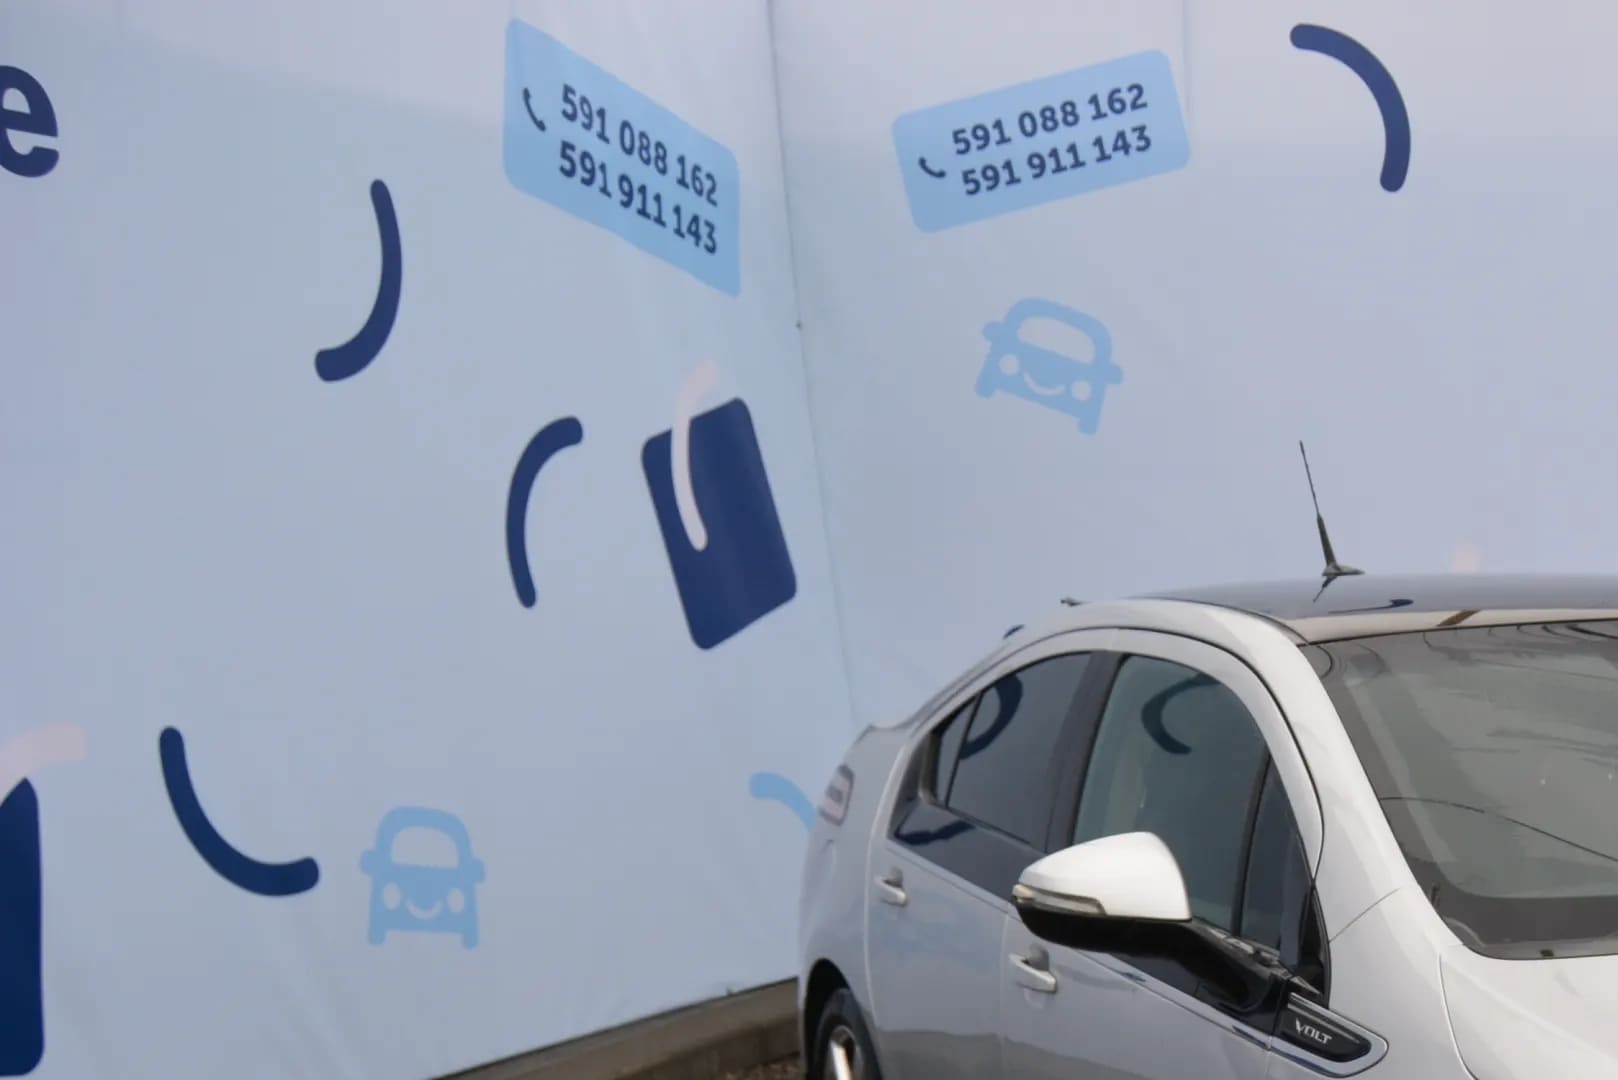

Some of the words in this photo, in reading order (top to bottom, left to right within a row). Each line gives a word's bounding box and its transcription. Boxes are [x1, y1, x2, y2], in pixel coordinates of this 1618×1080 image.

[561, 82, 610, 145] 591
[619, 119, 668, 177] 088
[676, 154, 718, 207] 162
[952, 119, 1012, 155] 591
[1018, 100, 1080, 138] 088
[1087, 83, 1148, 121] 162
[962, 159, 1021, 196] 591
[1027, 143, 1086, 179] 911
[1091, 125, 1152, 164] 143
[559, 140, 612, 199] 591
[617, 172, 667, 229] 911
[672, 203, 717, 255] 143
[1295, 1017, 1333, 1045] VOLT
